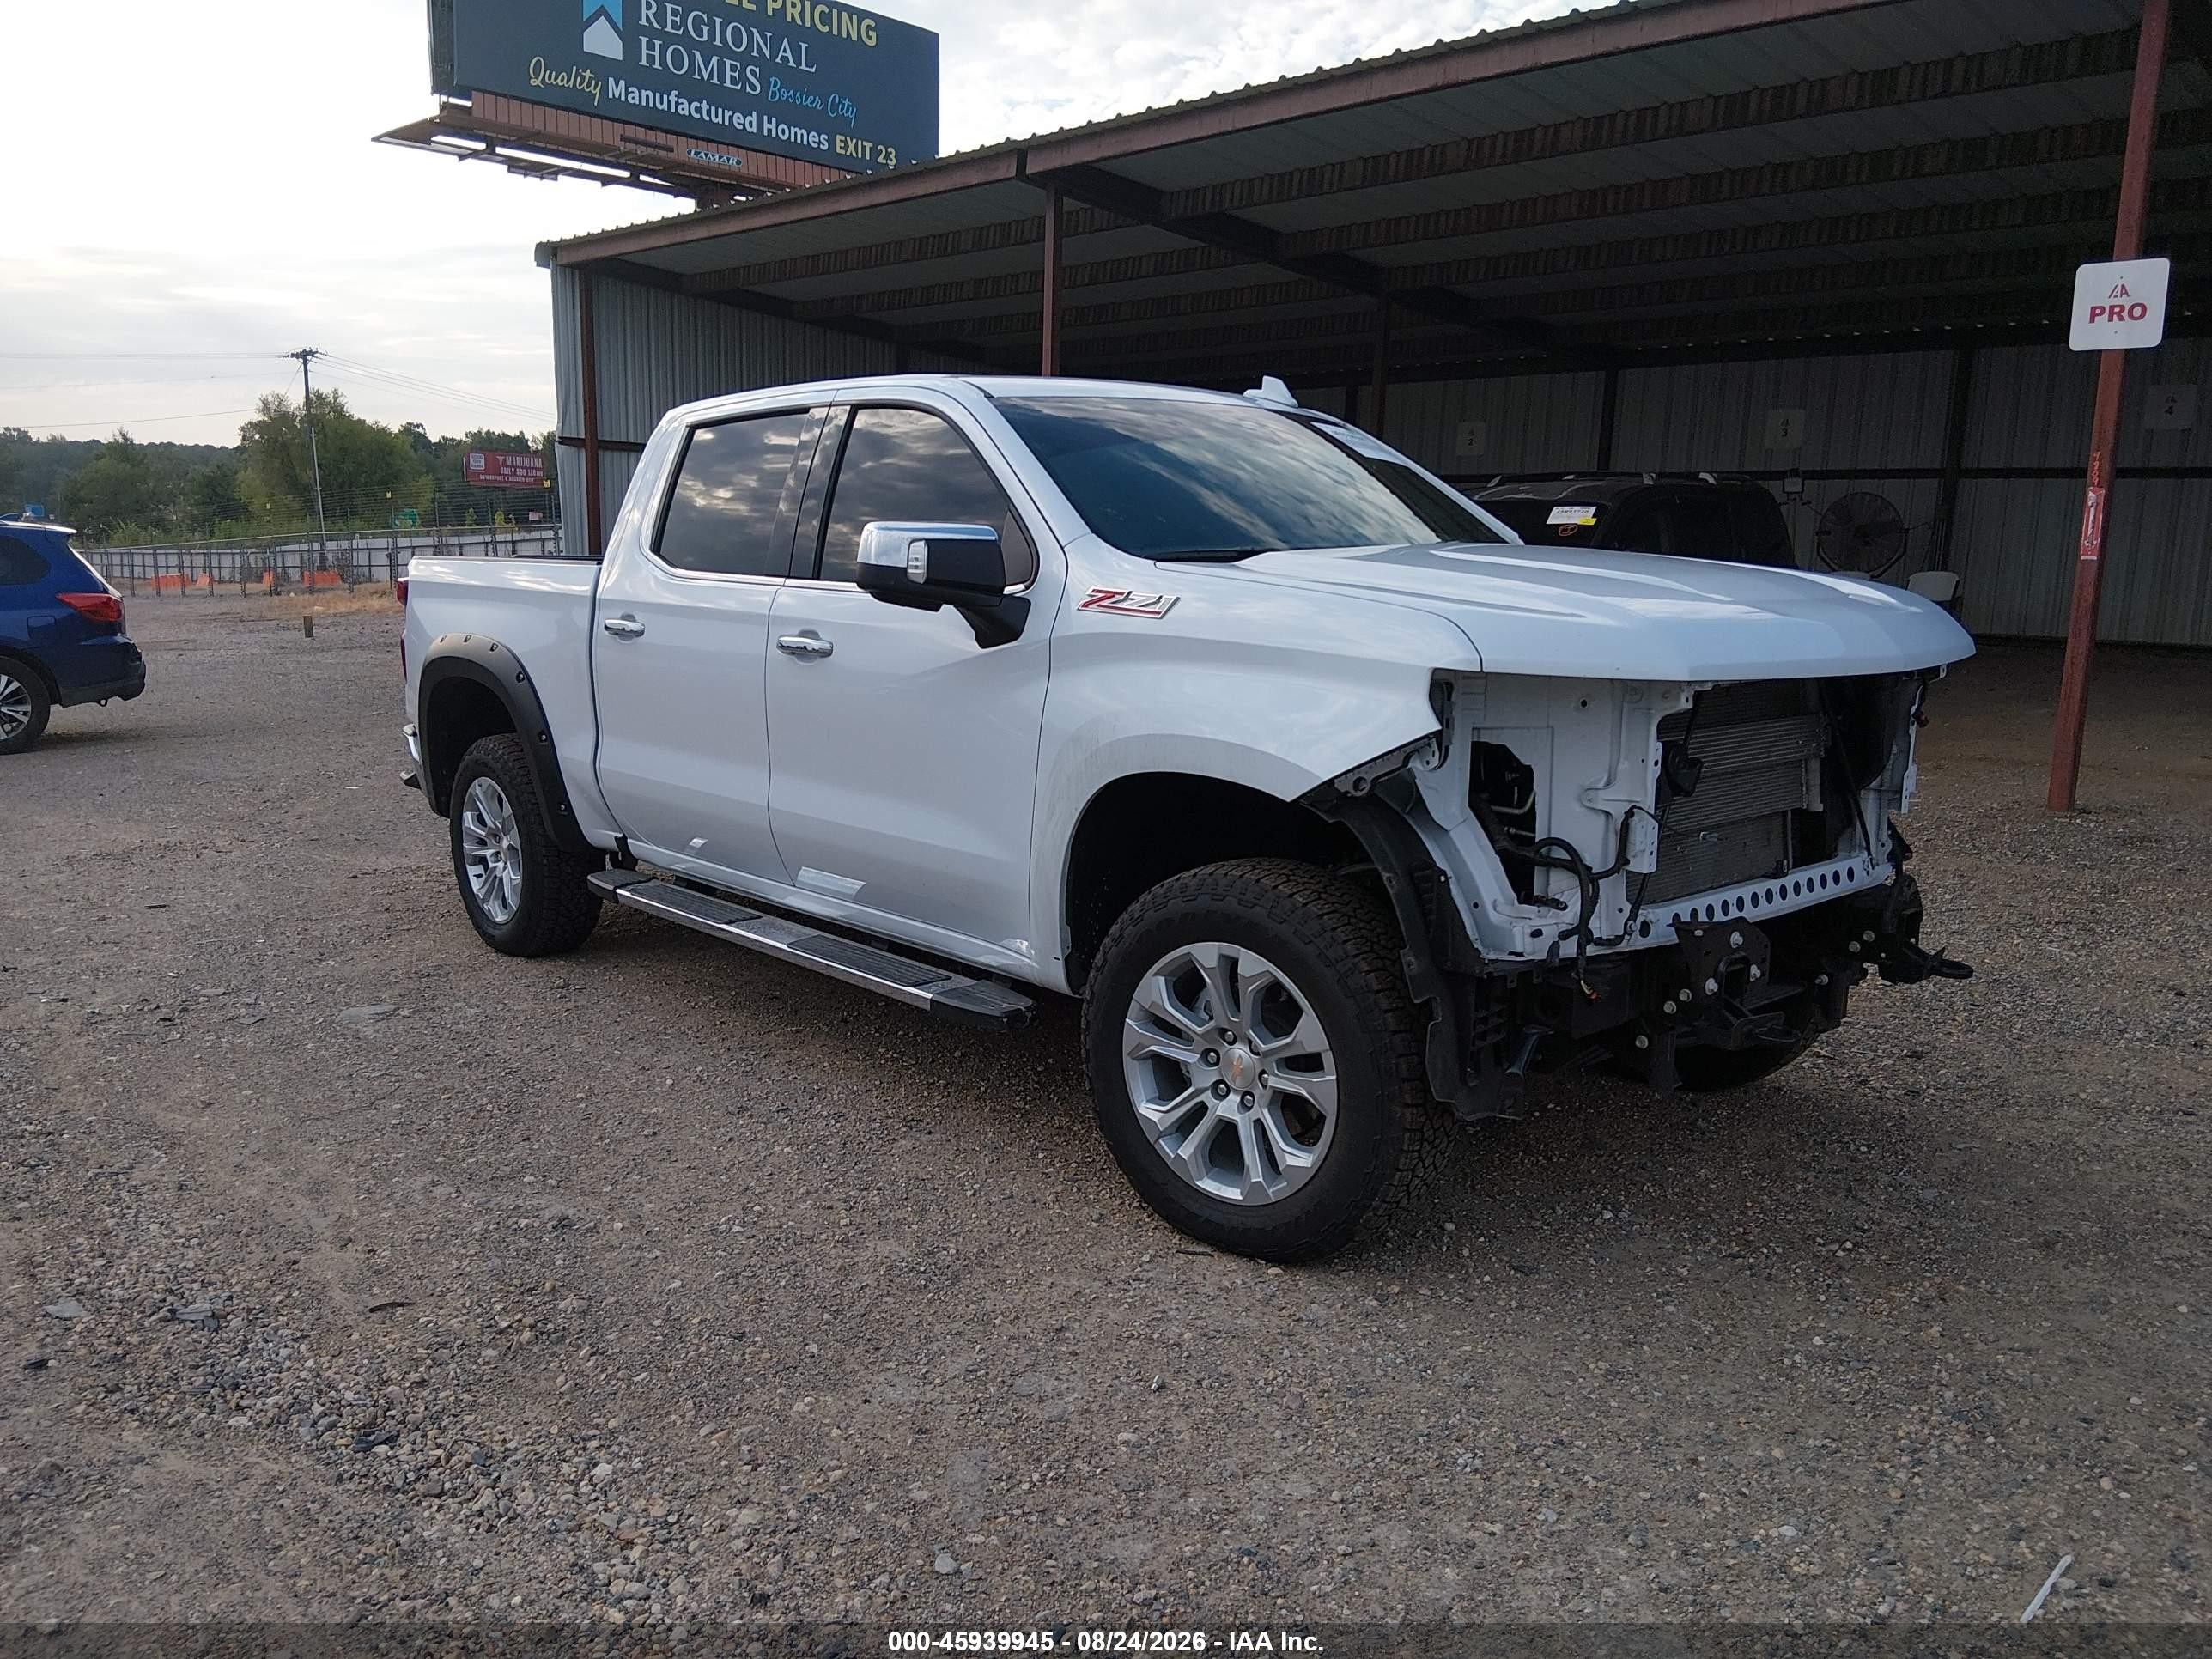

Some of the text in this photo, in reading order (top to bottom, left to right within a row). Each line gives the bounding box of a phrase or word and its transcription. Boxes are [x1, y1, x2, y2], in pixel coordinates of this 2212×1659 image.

[639, 0, 817, 72] REGIONAL
[767, 0, 877, 46] PRICING
[639, 36, 761, 95] HOMES
[529, 56, 896, 167] Quality Manufactured Homes EXIT 23
[768, 76, 857, 128] Bossier City
[690, 149, 738, 166] LAMAR
[2088, 302, 2148, 324] PRO
[506, 455, 543, 468] MARIJUANA
[1077, 586, 1181, 619] Z71
